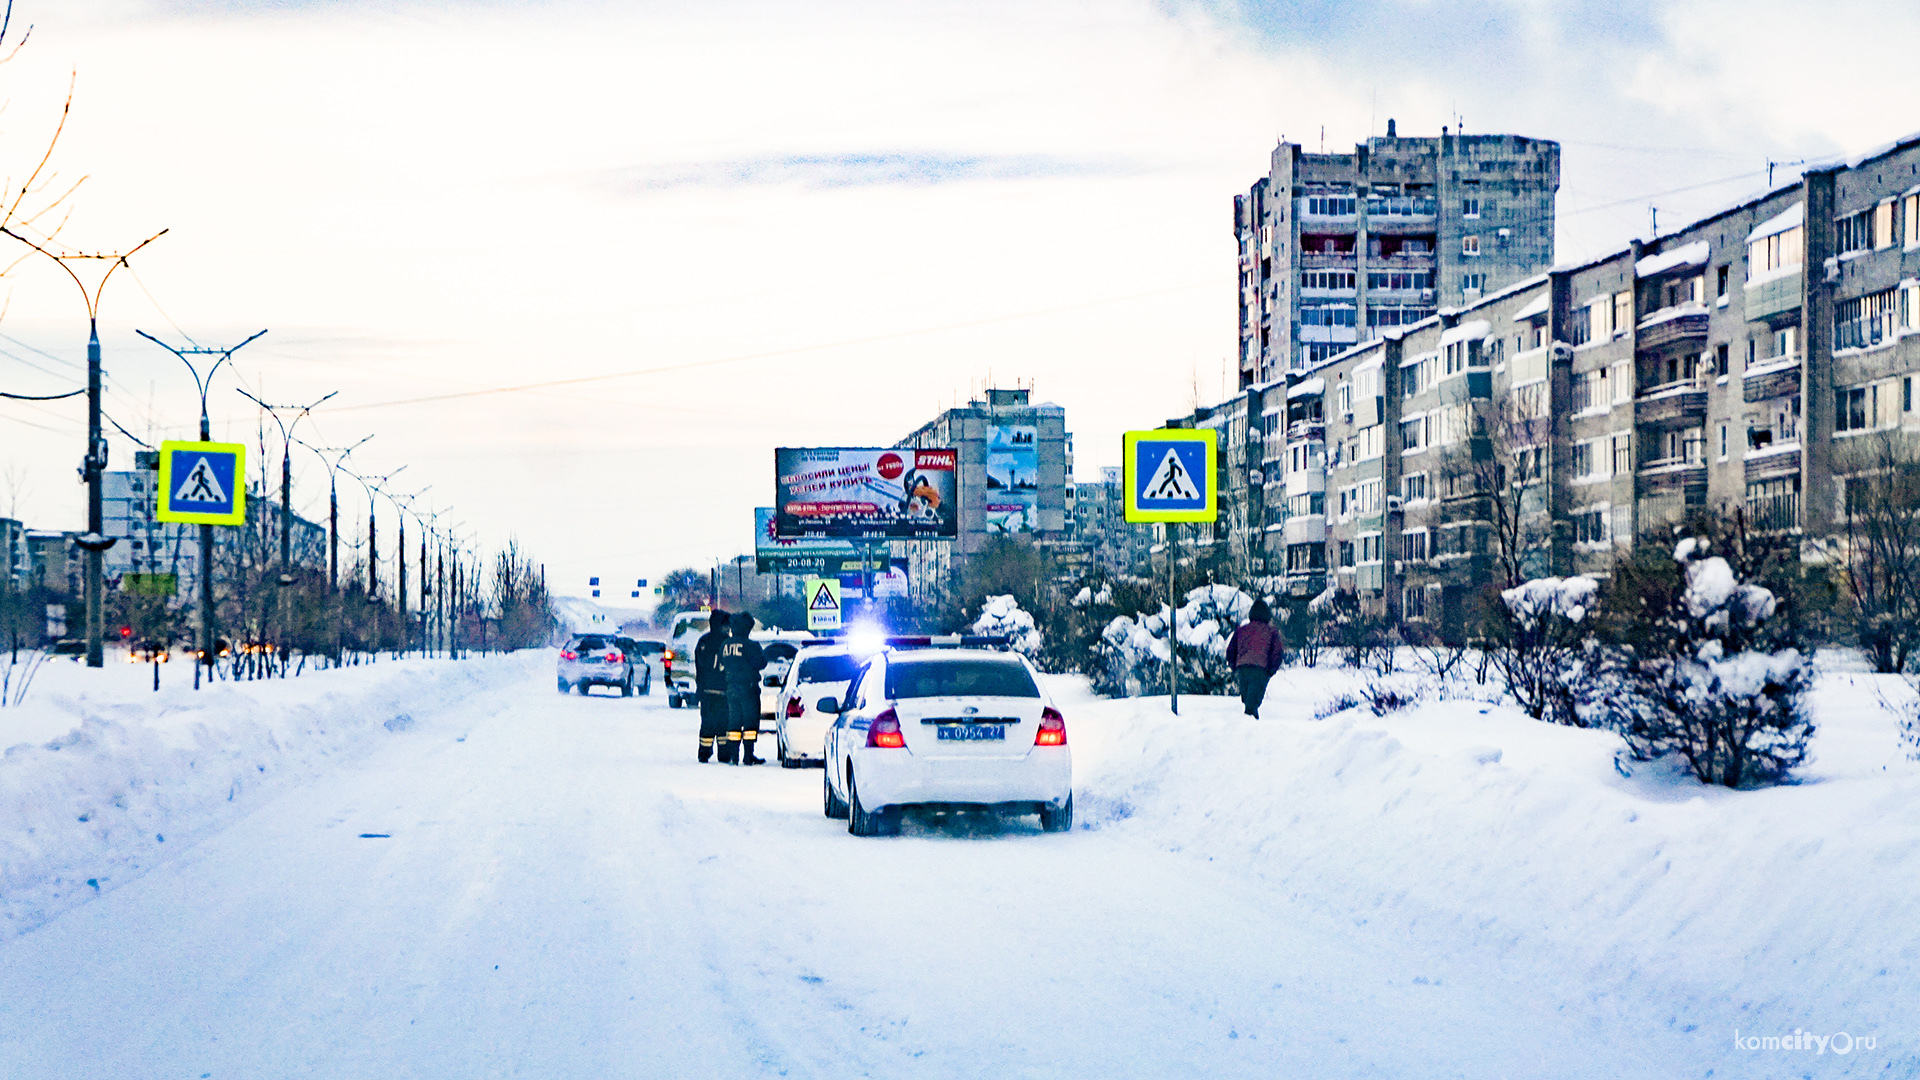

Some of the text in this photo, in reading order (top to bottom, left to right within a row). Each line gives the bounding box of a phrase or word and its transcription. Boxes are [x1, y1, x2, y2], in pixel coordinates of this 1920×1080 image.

[918, 455, 952, 466] STIHL
[829, 476, 872, 489] КУПИТЬ
[787, 558, 825, 568] 20-08-20
